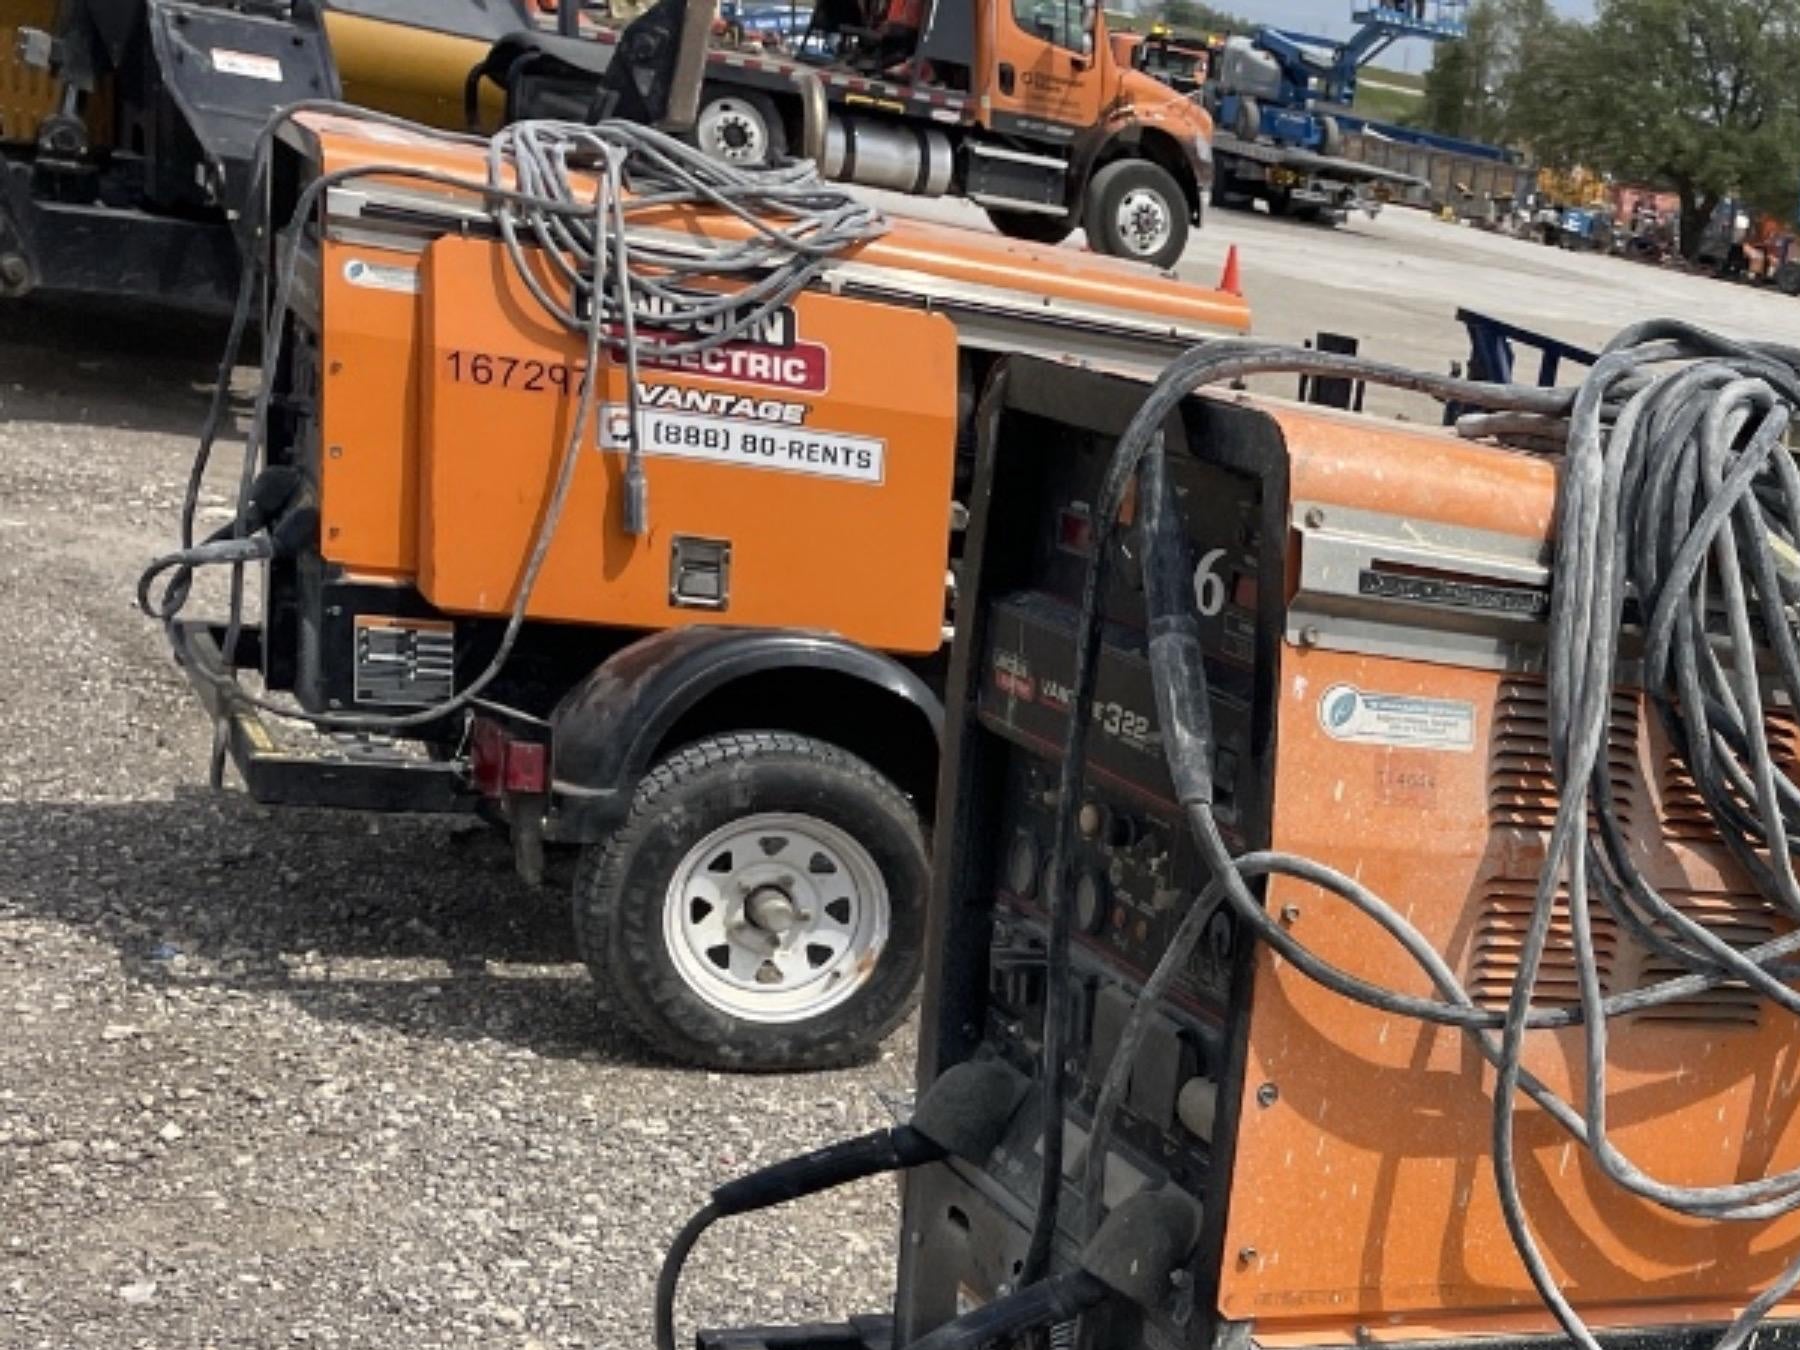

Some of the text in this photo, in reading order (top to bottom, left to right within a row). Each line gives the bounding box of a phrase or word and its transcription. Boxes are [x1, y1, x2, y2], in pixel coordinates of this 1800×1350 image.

[637, 384, 808, 425] VANTAGE
[653, 422, 872, 470] (888) 80-RENTS
[1193, 548, 1225, 617] 6
[1104, 702, 1150, 741] 322
